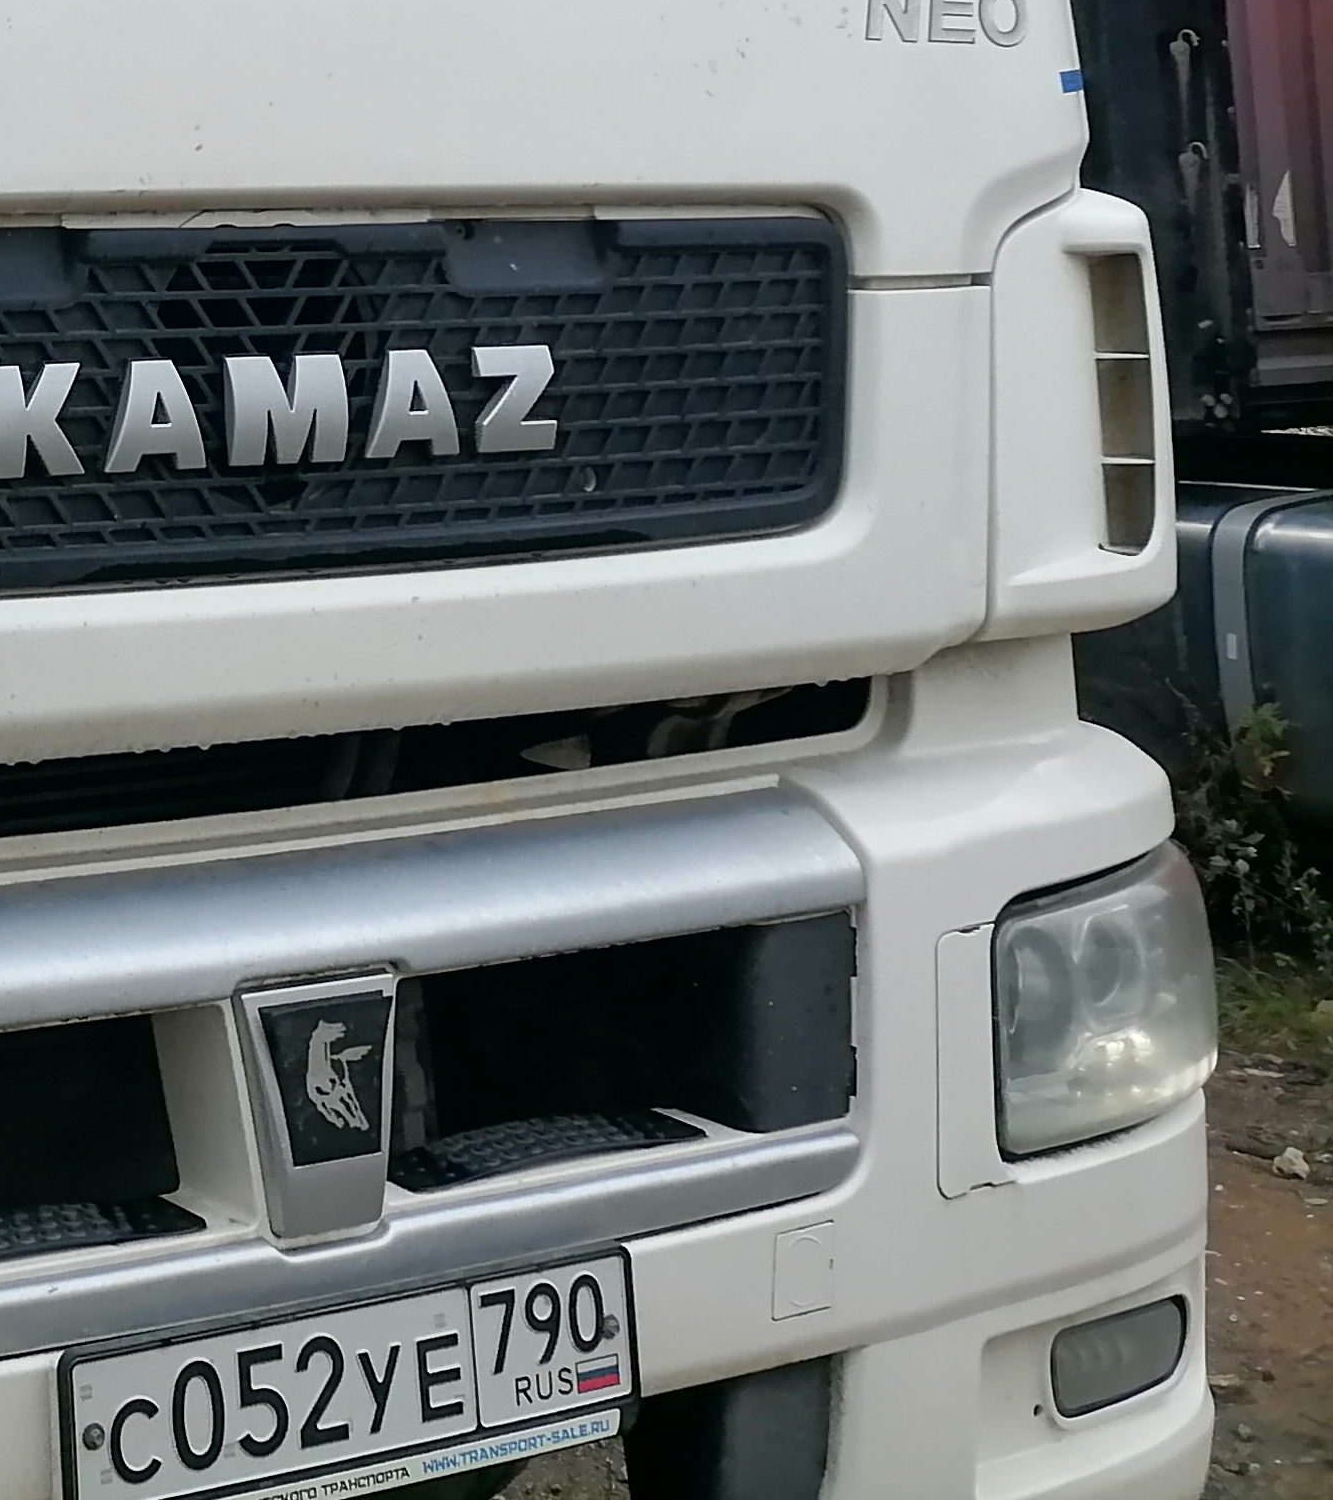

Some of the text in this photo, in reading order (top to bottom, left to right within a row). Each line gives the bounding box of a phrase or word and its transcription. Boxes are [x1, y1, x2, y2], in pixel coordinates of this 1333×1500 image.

[479, 1273, 604, 1376] 790
[515, 1367, 574, 1406] RUS
[422, 1419, 610, 1475] WWW.TRANSPORT-SALE.RU
[321, 1466, 411, 1497] ТРАНСПОРТА
